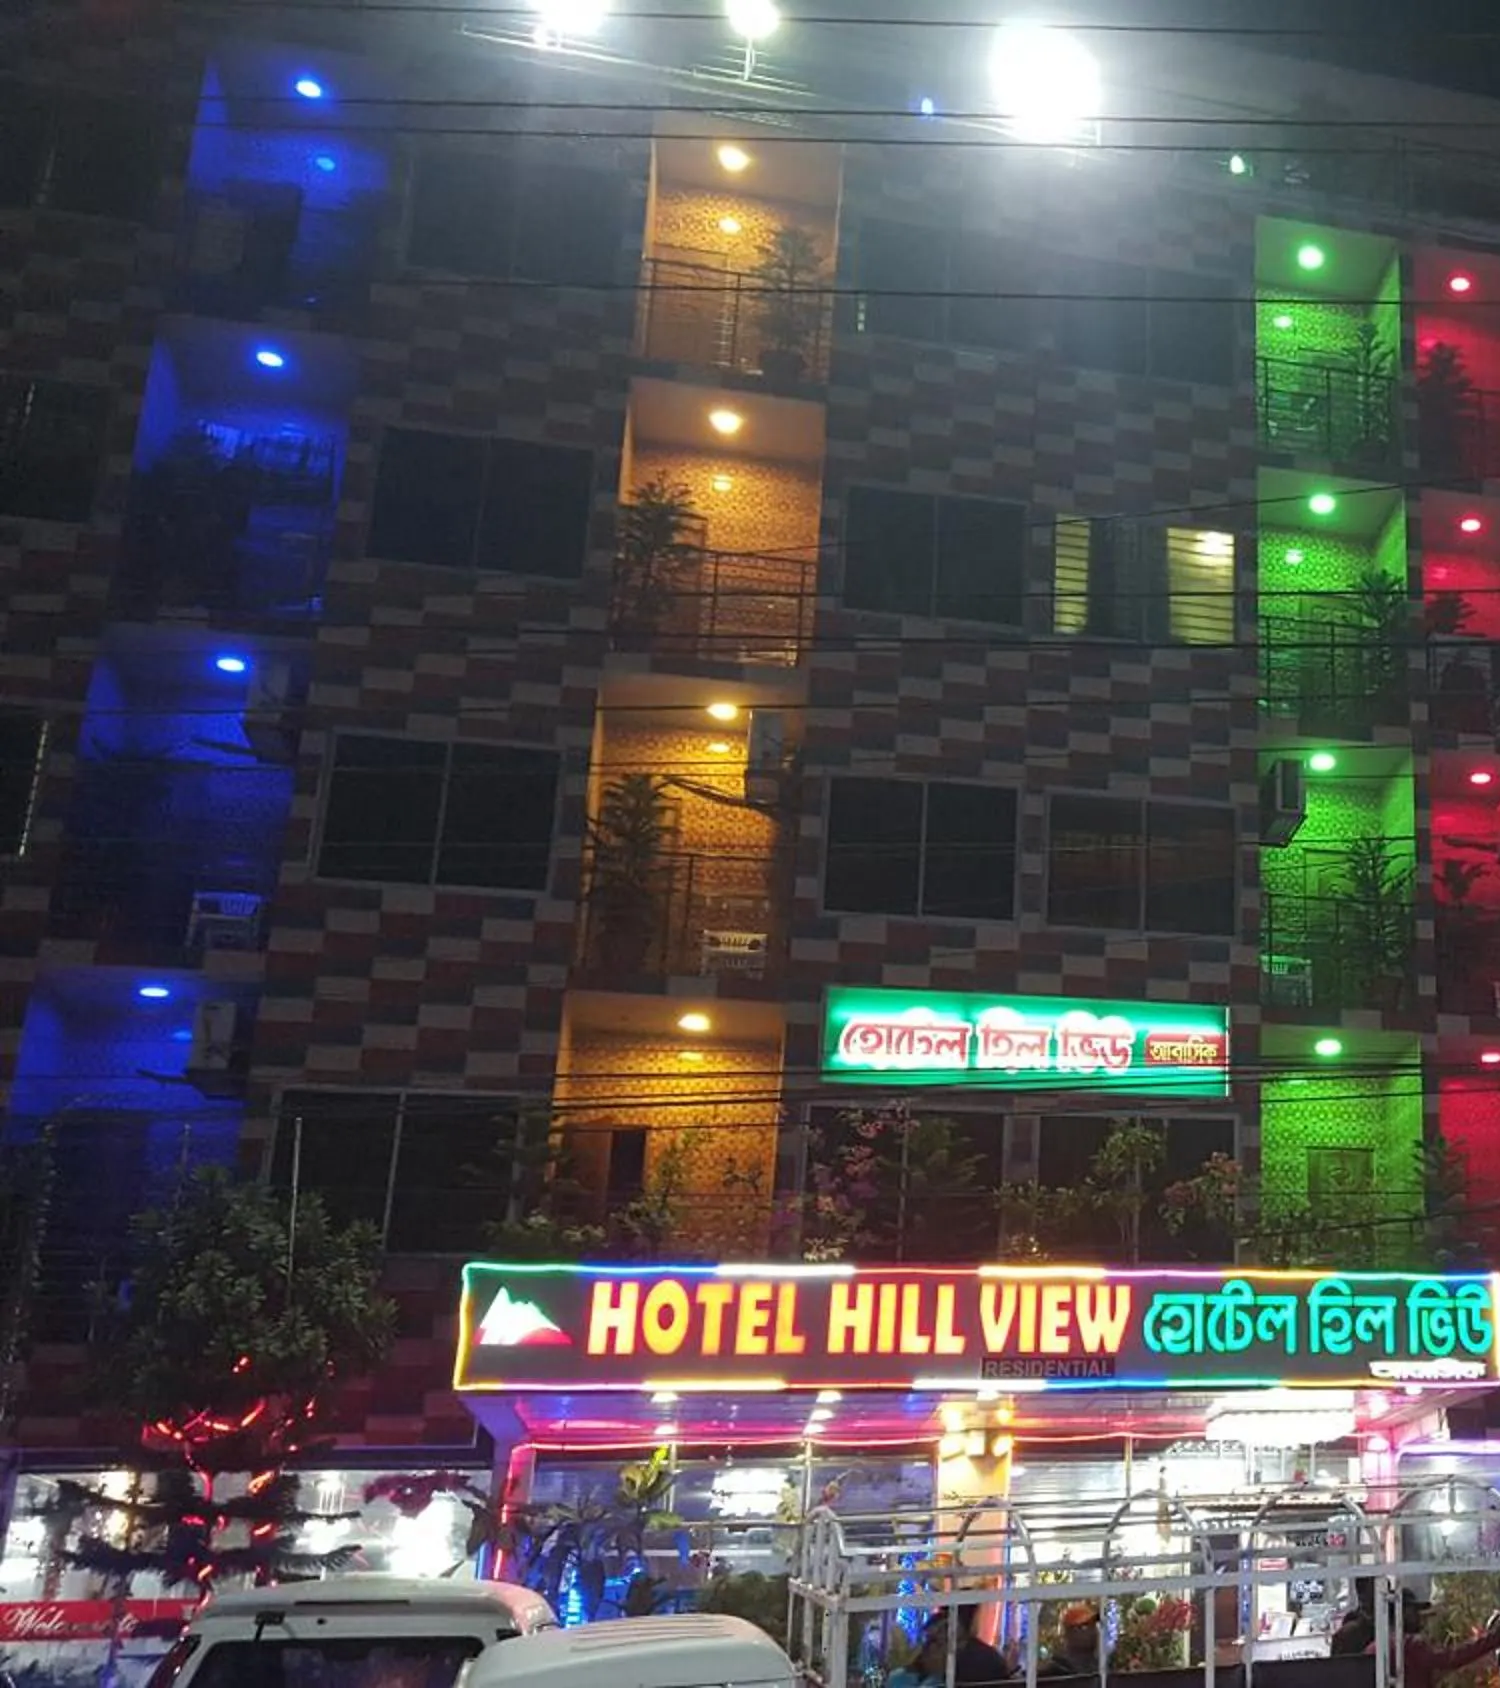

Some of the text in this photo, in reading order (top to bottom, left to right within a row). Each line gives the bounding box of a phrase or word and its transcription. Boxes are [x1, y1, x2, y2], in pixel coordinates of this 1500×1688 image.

[1149, 1034, 1219, 1064] আবাসিক
[587, 1280, 1131, 1355] HOTEL HILL VIEW
[1143, 1278, 1495, 1356] হোটেল হিল ভিউ
[983, 1359, 1113, 1378] RESIDENTIAL
